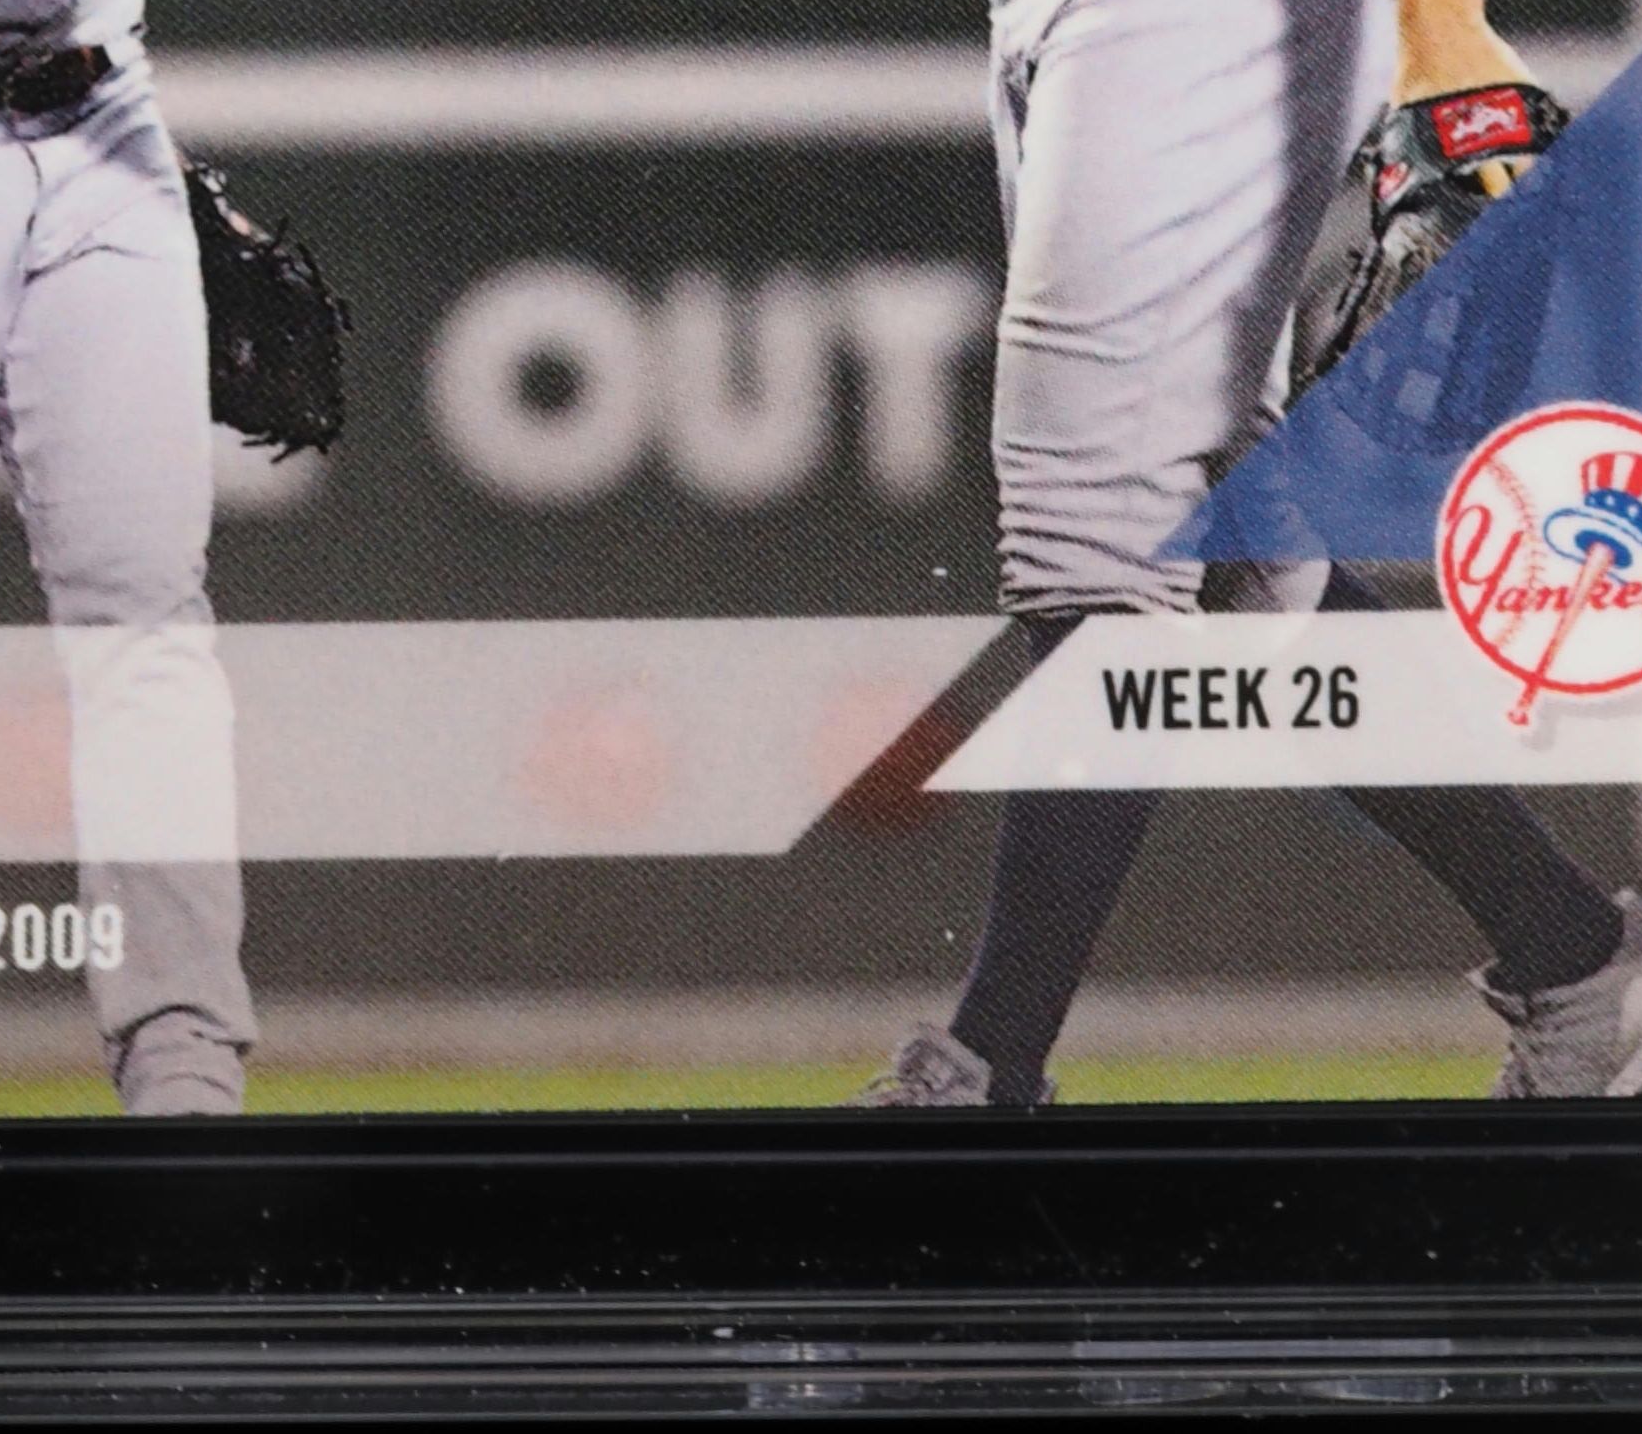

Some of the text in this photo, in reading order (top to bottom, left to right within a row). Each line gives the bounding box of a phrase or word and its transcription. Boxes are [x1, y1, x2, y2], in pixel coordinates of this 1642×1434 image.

[424, 254, 1001, 511] OUT
[1101, 664, 1361, 732] WEEK 26
